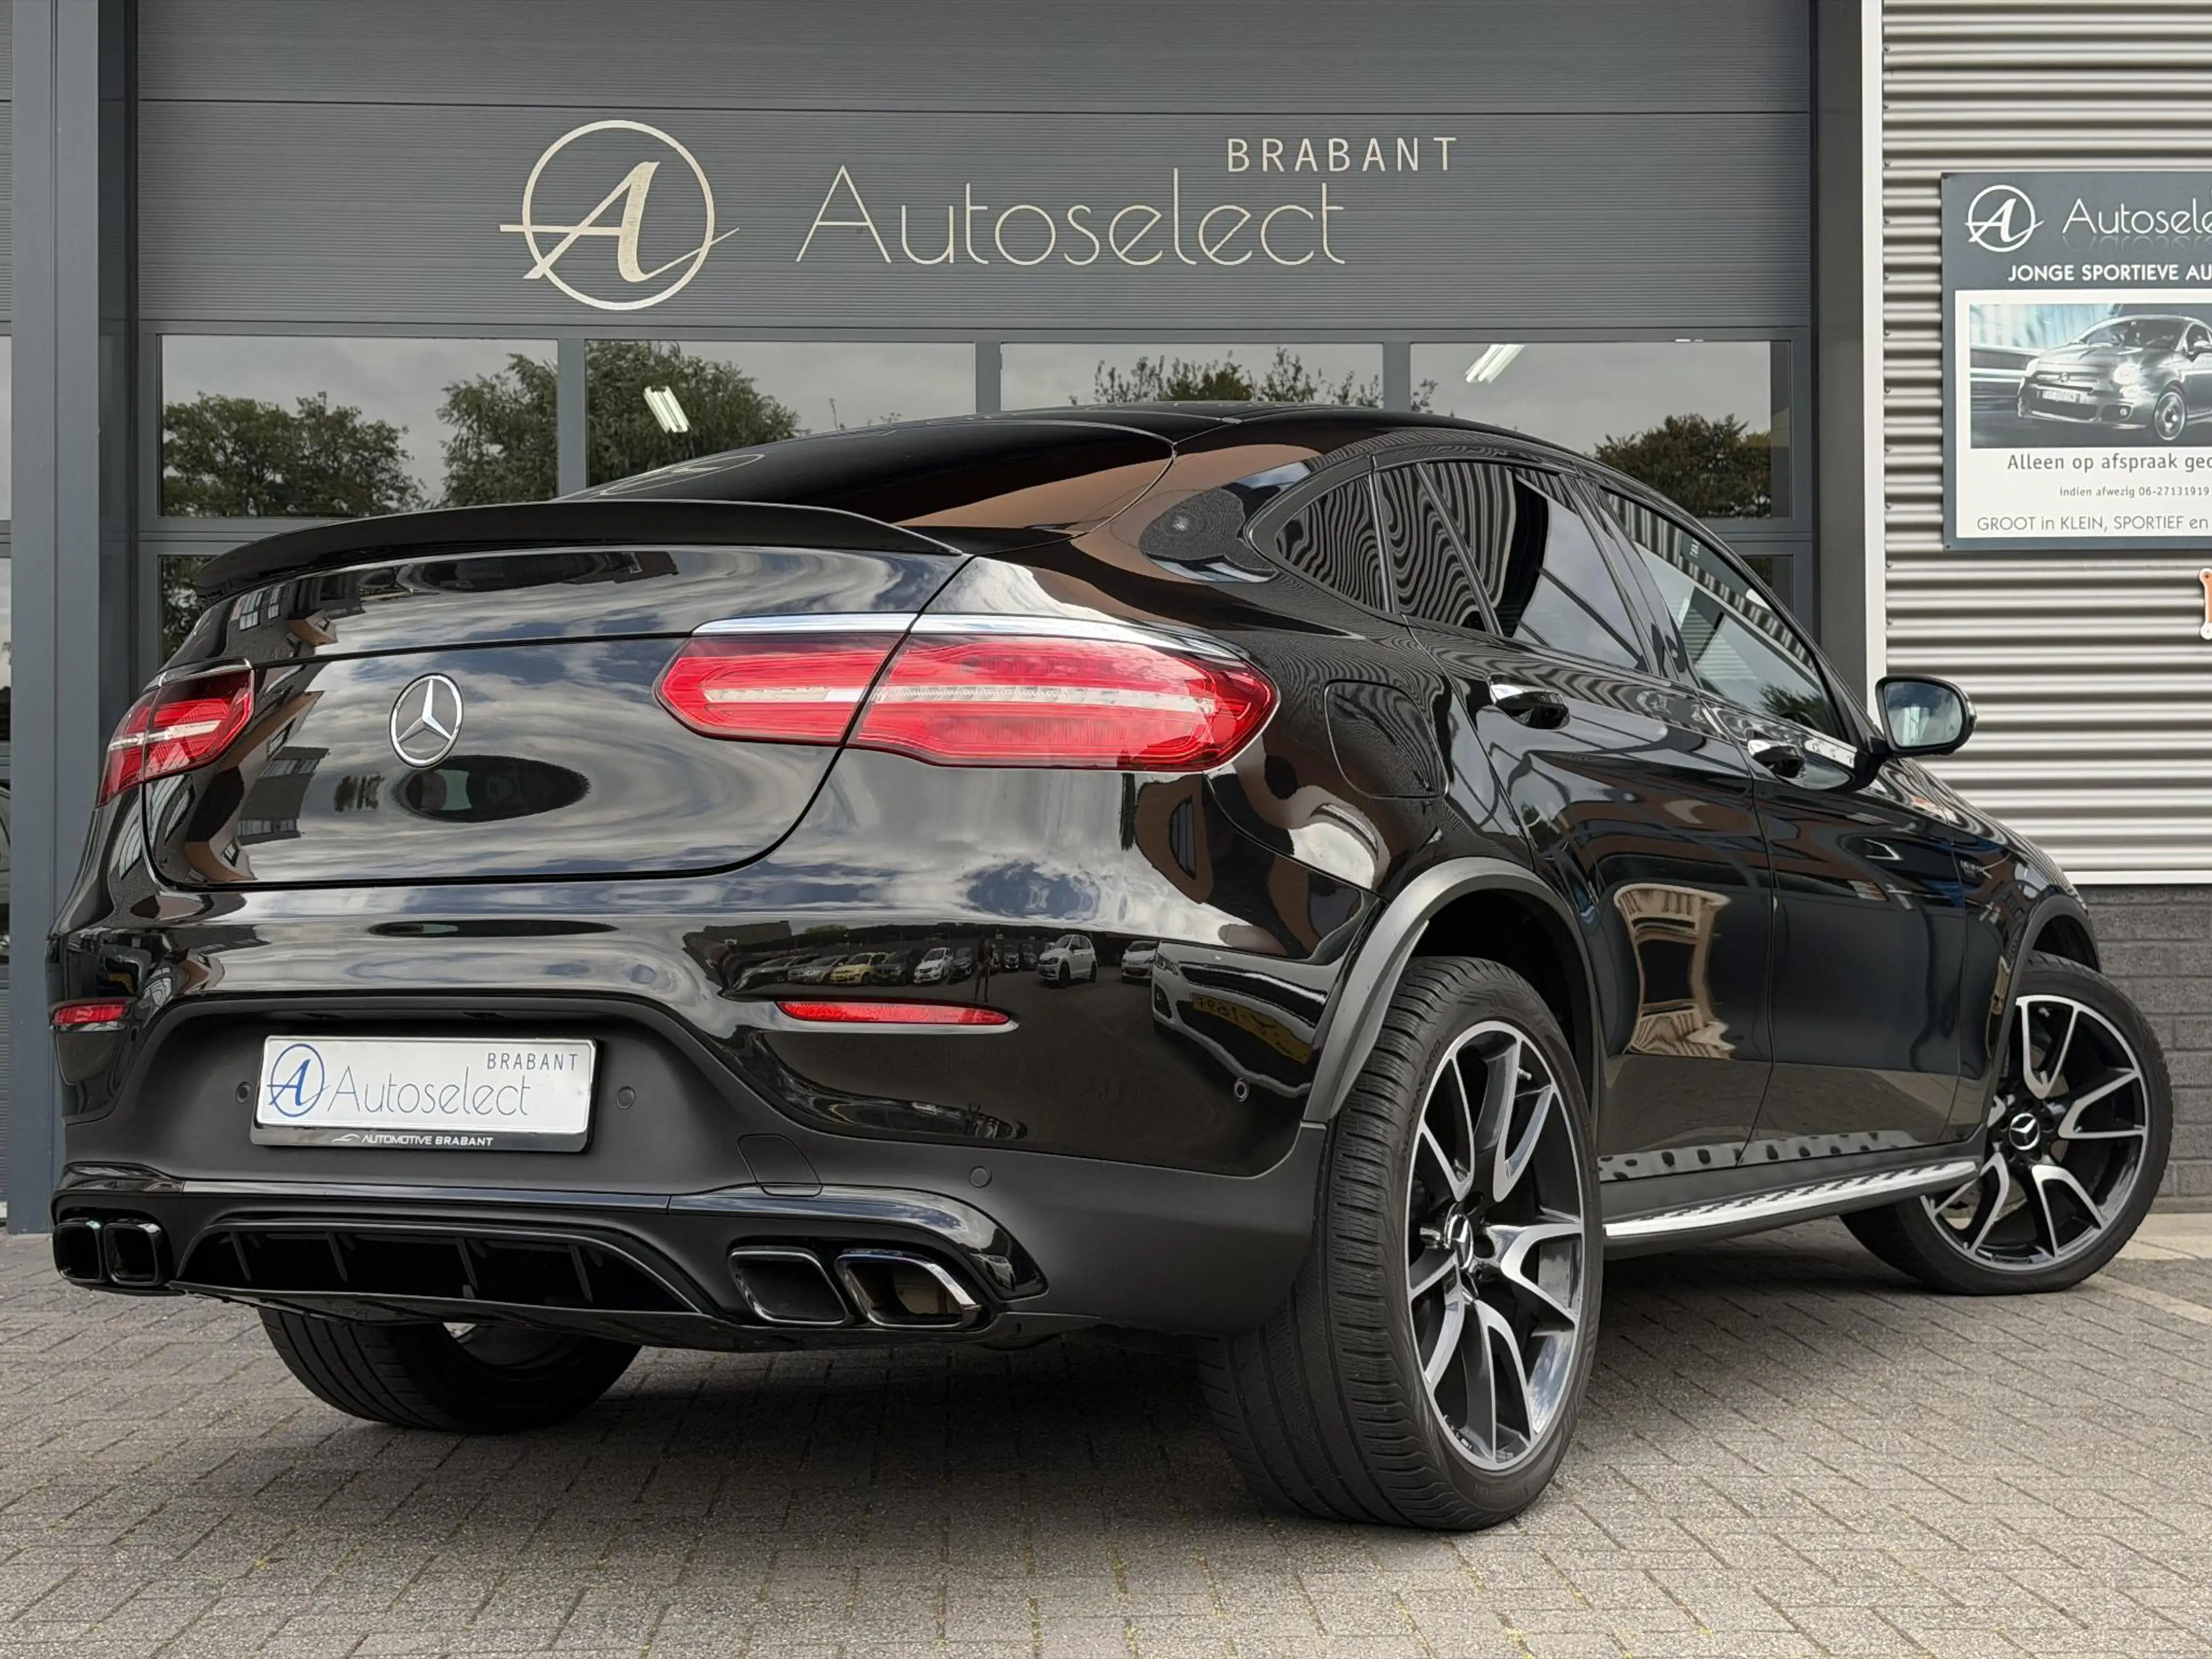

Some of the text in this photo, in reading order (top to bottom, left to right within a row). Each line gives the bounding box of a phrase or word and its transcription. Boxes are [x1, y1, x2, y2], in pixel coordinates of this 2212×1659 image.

[1228, 137, 1457, 174] BRABANT
[796, 165, 1350, 267] Autoselect
[2008, 264, 2075, 282] JONGE
[2082, 264, 2180, 281] SPORTIEVE
[2008, 454, 2064, 470] Alleen
[2073, 458, 2094, 474] op
[2101, 453, 2178, 473] afspraak
[2096, 486, 2135, 499] afwezig
[2138, 486, 2210, 497] 06-27131919
[1977, 515, 2209, 533] GROOT in KLEIN, SPORTIEF en
[487, 1052, 579, 1072] BRABANT
[327, 1065, 531, 1116] Autoselect
[361, 1134, 493, 1147] AUTOMOTIVE BRABANT
